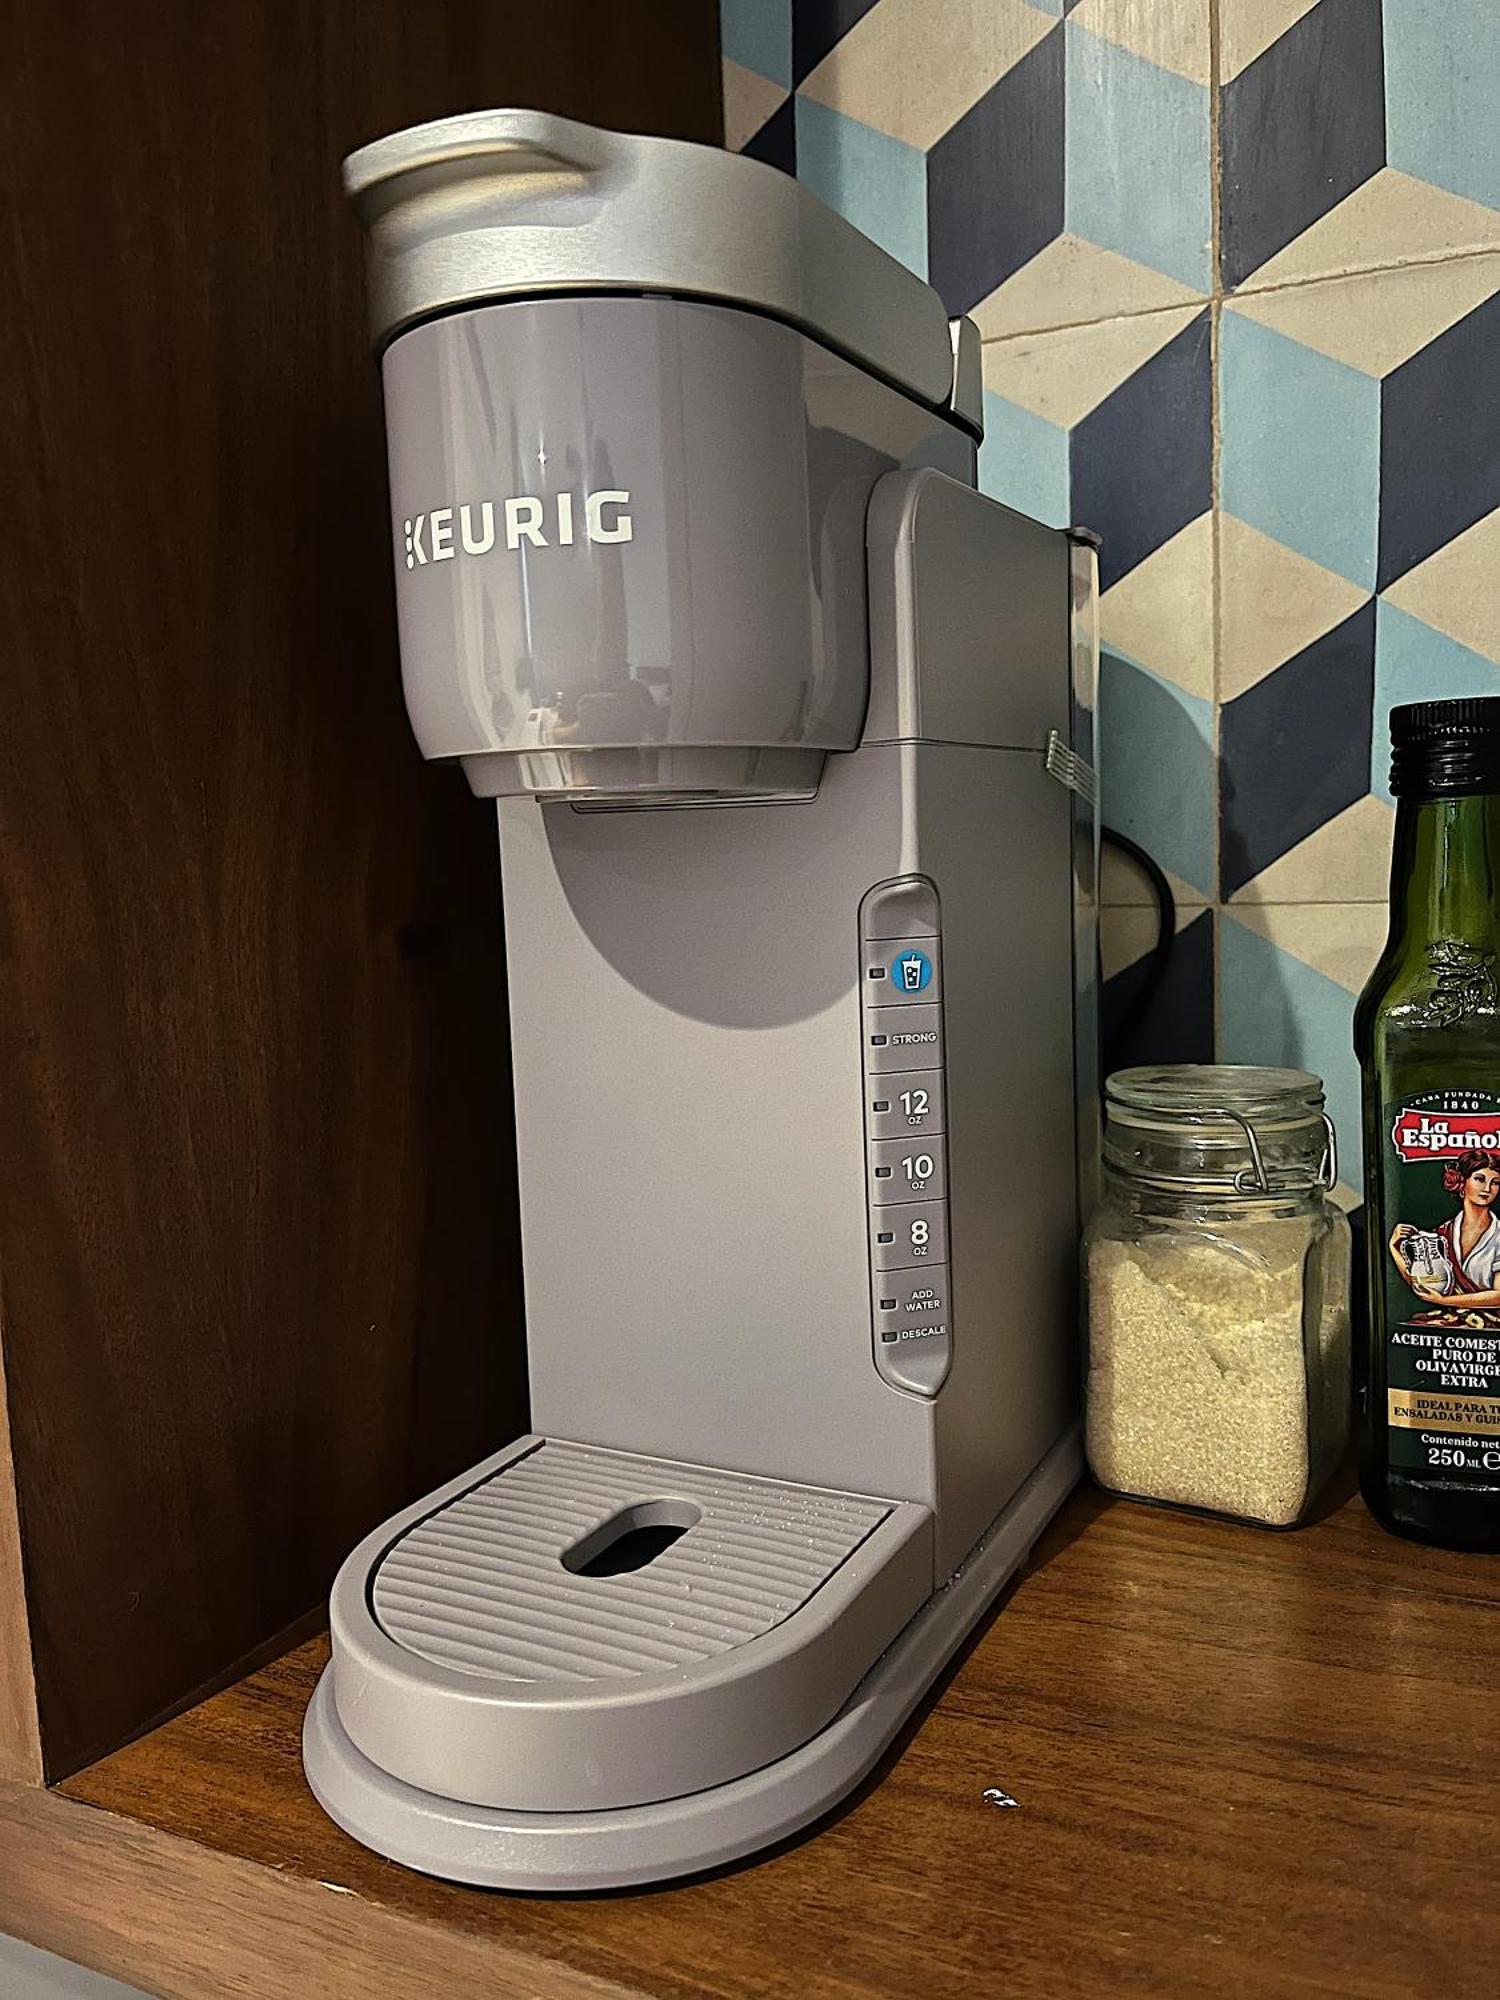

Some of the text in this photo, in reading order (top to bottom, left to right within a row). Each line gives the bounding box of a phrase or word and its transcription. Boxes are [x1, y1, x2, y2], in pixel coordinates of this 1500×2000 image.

[404, 490, 633, 569] KEURIG
[892, 1032, 937, 1045] STRONG
[899, 1089, 929, 1116] 12
[1443, 1100, 1480, 1110] 1840
[1420, 1118, 1449, 1134] La
[902, 1154, 934, 1180] 10
[911, 1219, 929, 1245] 8
[911, 1289, 934, 1300] ADD
[905, 1299, 941, 1312] WATER
[901, 1325, 946, 1340] DESCALE
[1391, 1332, 1442, 1348] ACEITE
[1432, 1348, 1497, 1363] PURO DE
[1415, 1360, 1459, 1374] OLIVA
[1440, 1374, 1488, 1388] EXTRA
[1416, 1399, 1453, 1412] IDEAL
[1454, 1401, 1488, 1414] PARA
[1393, 1406, 1463, 1423] ENSALADAS
[1464, 1413, 1473, 1423] Y
[1421, 1433, 1479, 1448] Contenido
[1428, 1448, 1465, 1467] 250
